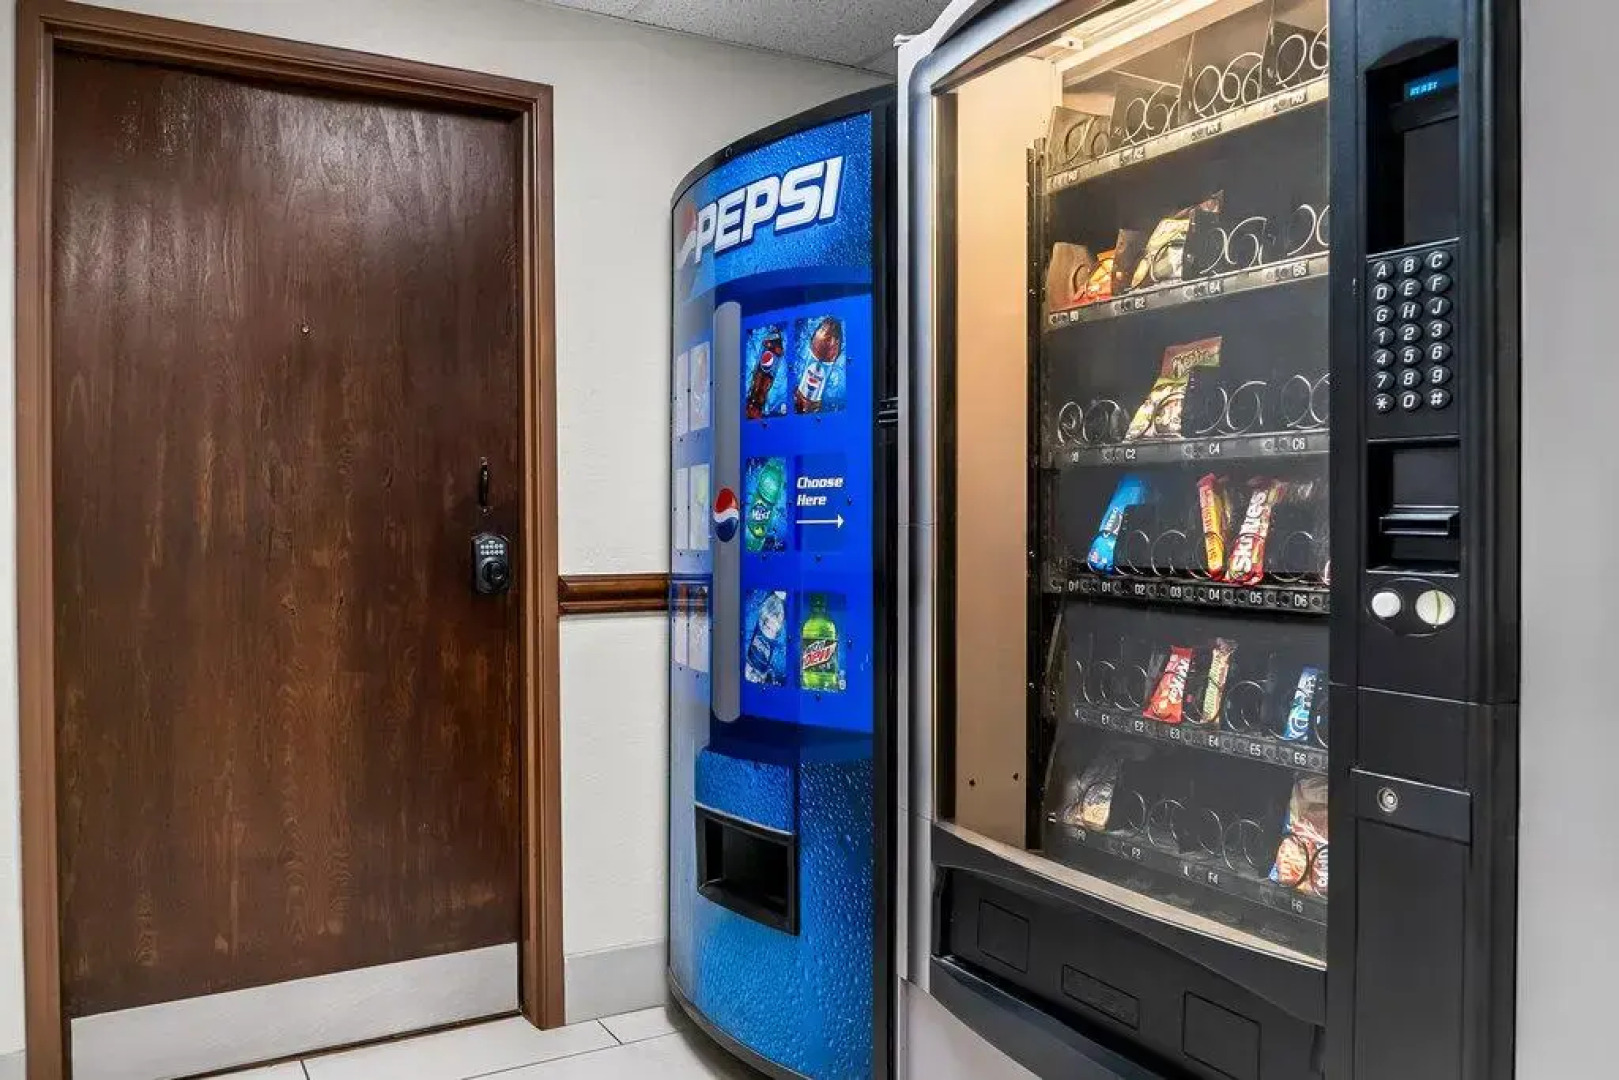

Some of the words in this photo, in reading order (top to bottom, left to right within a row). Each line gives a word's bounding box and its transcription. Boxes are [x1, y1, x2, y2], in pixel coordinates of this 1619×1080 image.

[694, 155, 844, 264] PEPSI
[1377, 264, 1388, 278] A
[1404, 258, 1415, 273] B
[1431, 254, 1443, 268] C
[1377, 287, 1388, 300] D
[1404, 282, 1415, 297] E
[1431, 276, 1443, 292] F
[1377, 309, 1389, 322] G
[1403, 304, 1416, 319] H
[1431, 300, 1443, 315] J
[1379, 330, 1386, 344] 1
[1404, 326, 1415, 341] 2
[1431, 323, 1443, 338] 3
[1376, 353, 1386, 366] 4
[1403, 348, 1415, 363] 5
[1431, 345, 1443, 360] 6
[1377, 374, 1388, 388] 7
[1403, 372, 1414, 387] 8
[1431, 369, 1443, 384] 9
[1403, 394, 1415, 409] 0
[1430, 392, 1443, 406] #
[1125, 448, 1136, 460] C2
[1209, 443, 1220, 455] C4
[796, 476, 843, 489] Choose
[796, 494, 827, 507] Here
[1134, 720, 1144, 732] E2
[1169, 727, 1180, 739] E3
[1208, 734, 1219, 748] E4
[1250, 743, 1261, 757] E5
[1294, 752, 1307, 766] E6
